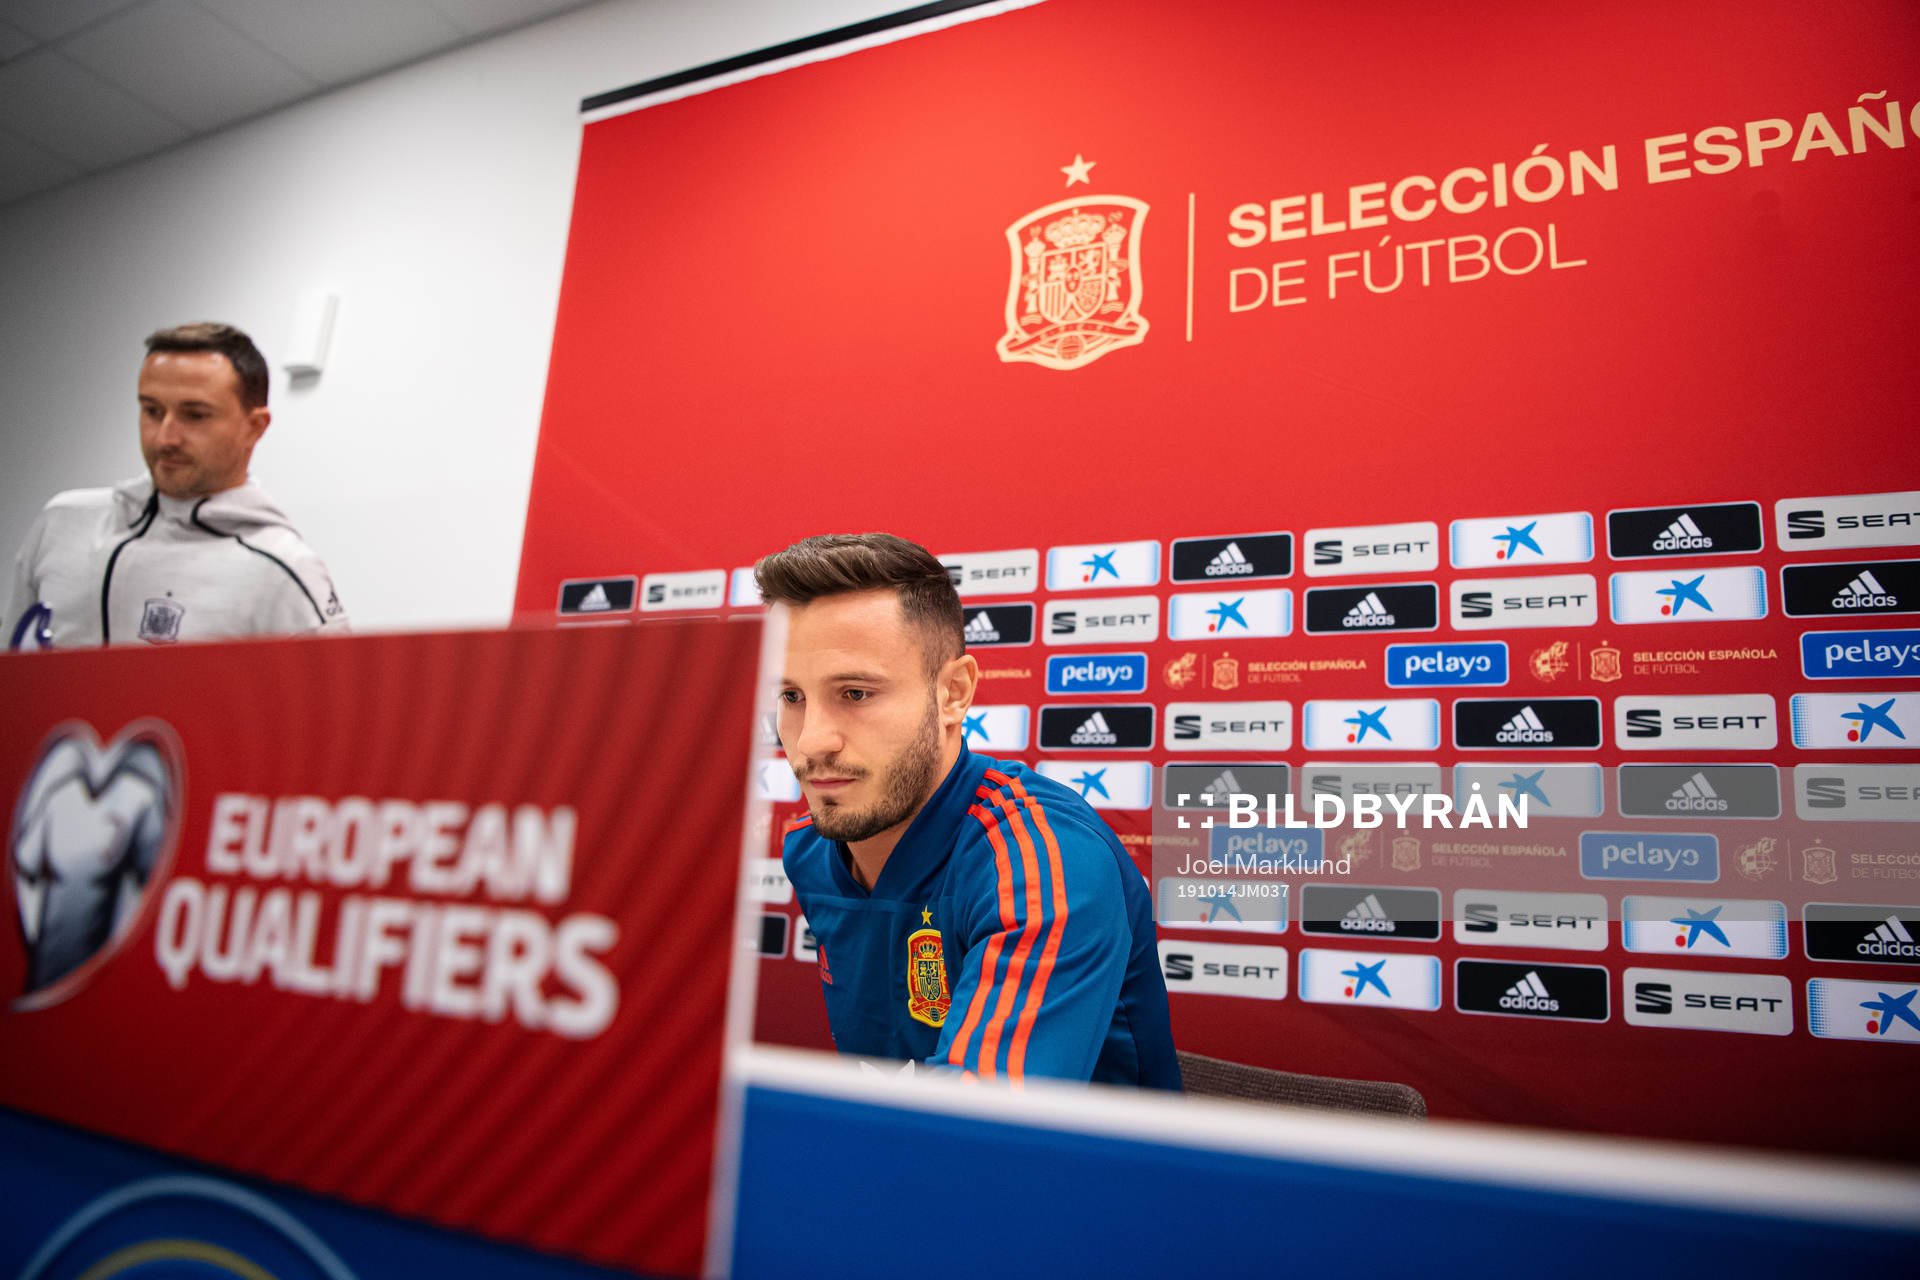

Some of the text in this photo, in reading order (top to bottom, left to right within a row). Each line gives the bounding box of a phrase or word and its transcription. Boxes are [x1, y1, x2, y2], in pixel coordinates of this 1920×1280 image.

[1228, 144, 1619, 248] SELECCIÓN
[1228, 222, 1587, 312] DE FÚTBOL
[1353, 541, 1431, 557] SEAT
[1652, 534, 1712, 551] adidas
[970, 566, 1031, 580] SEAT
[1205, 562, 1253, 576] adidas
[1503, 595, 1588, 610] SEAT
[1832, 593, 1898, 609] adidas
[1085, 614, 1151, 627] SEAT
[1343, 612, 1395, 627] adidas
[1633, 647, 1778, 663] SELECCIÓN ESPAÑOLA
[1248, 660, 1307, 672] SELECCIÓN
[1405, 650, 1491, 679] pelayo
[1633, 665, 1650, 675] DE
[1061, 661, 1133, 687] pelayo
[1211, 721, 1285, 733] SEAT
[1673, 716, 1767, 729] SEAT
[1070, 733, 1117, 744] adidas
[1496, 729, 1554, 743] adidas
[1665, 795, 1728, 812] adidas
[206, 792, 577, 903] EUROPEAN
[1432, 841, 1500, 856] SELECCIÓN
[1602, 840, 1699, 872] pelayo
[1852, 868, 1870, 879] DE
[1340, 917, 1395, 933] adidas
[1509, 912, 1599, 930] SEAT
[155, 877, 619, 1040] QUALIFIERS
[1203, 962, 1280, 980] SEAT
[1499, 994, 1559, 1012] adidas
[1684, 993, 1783, 1013] SEAT
